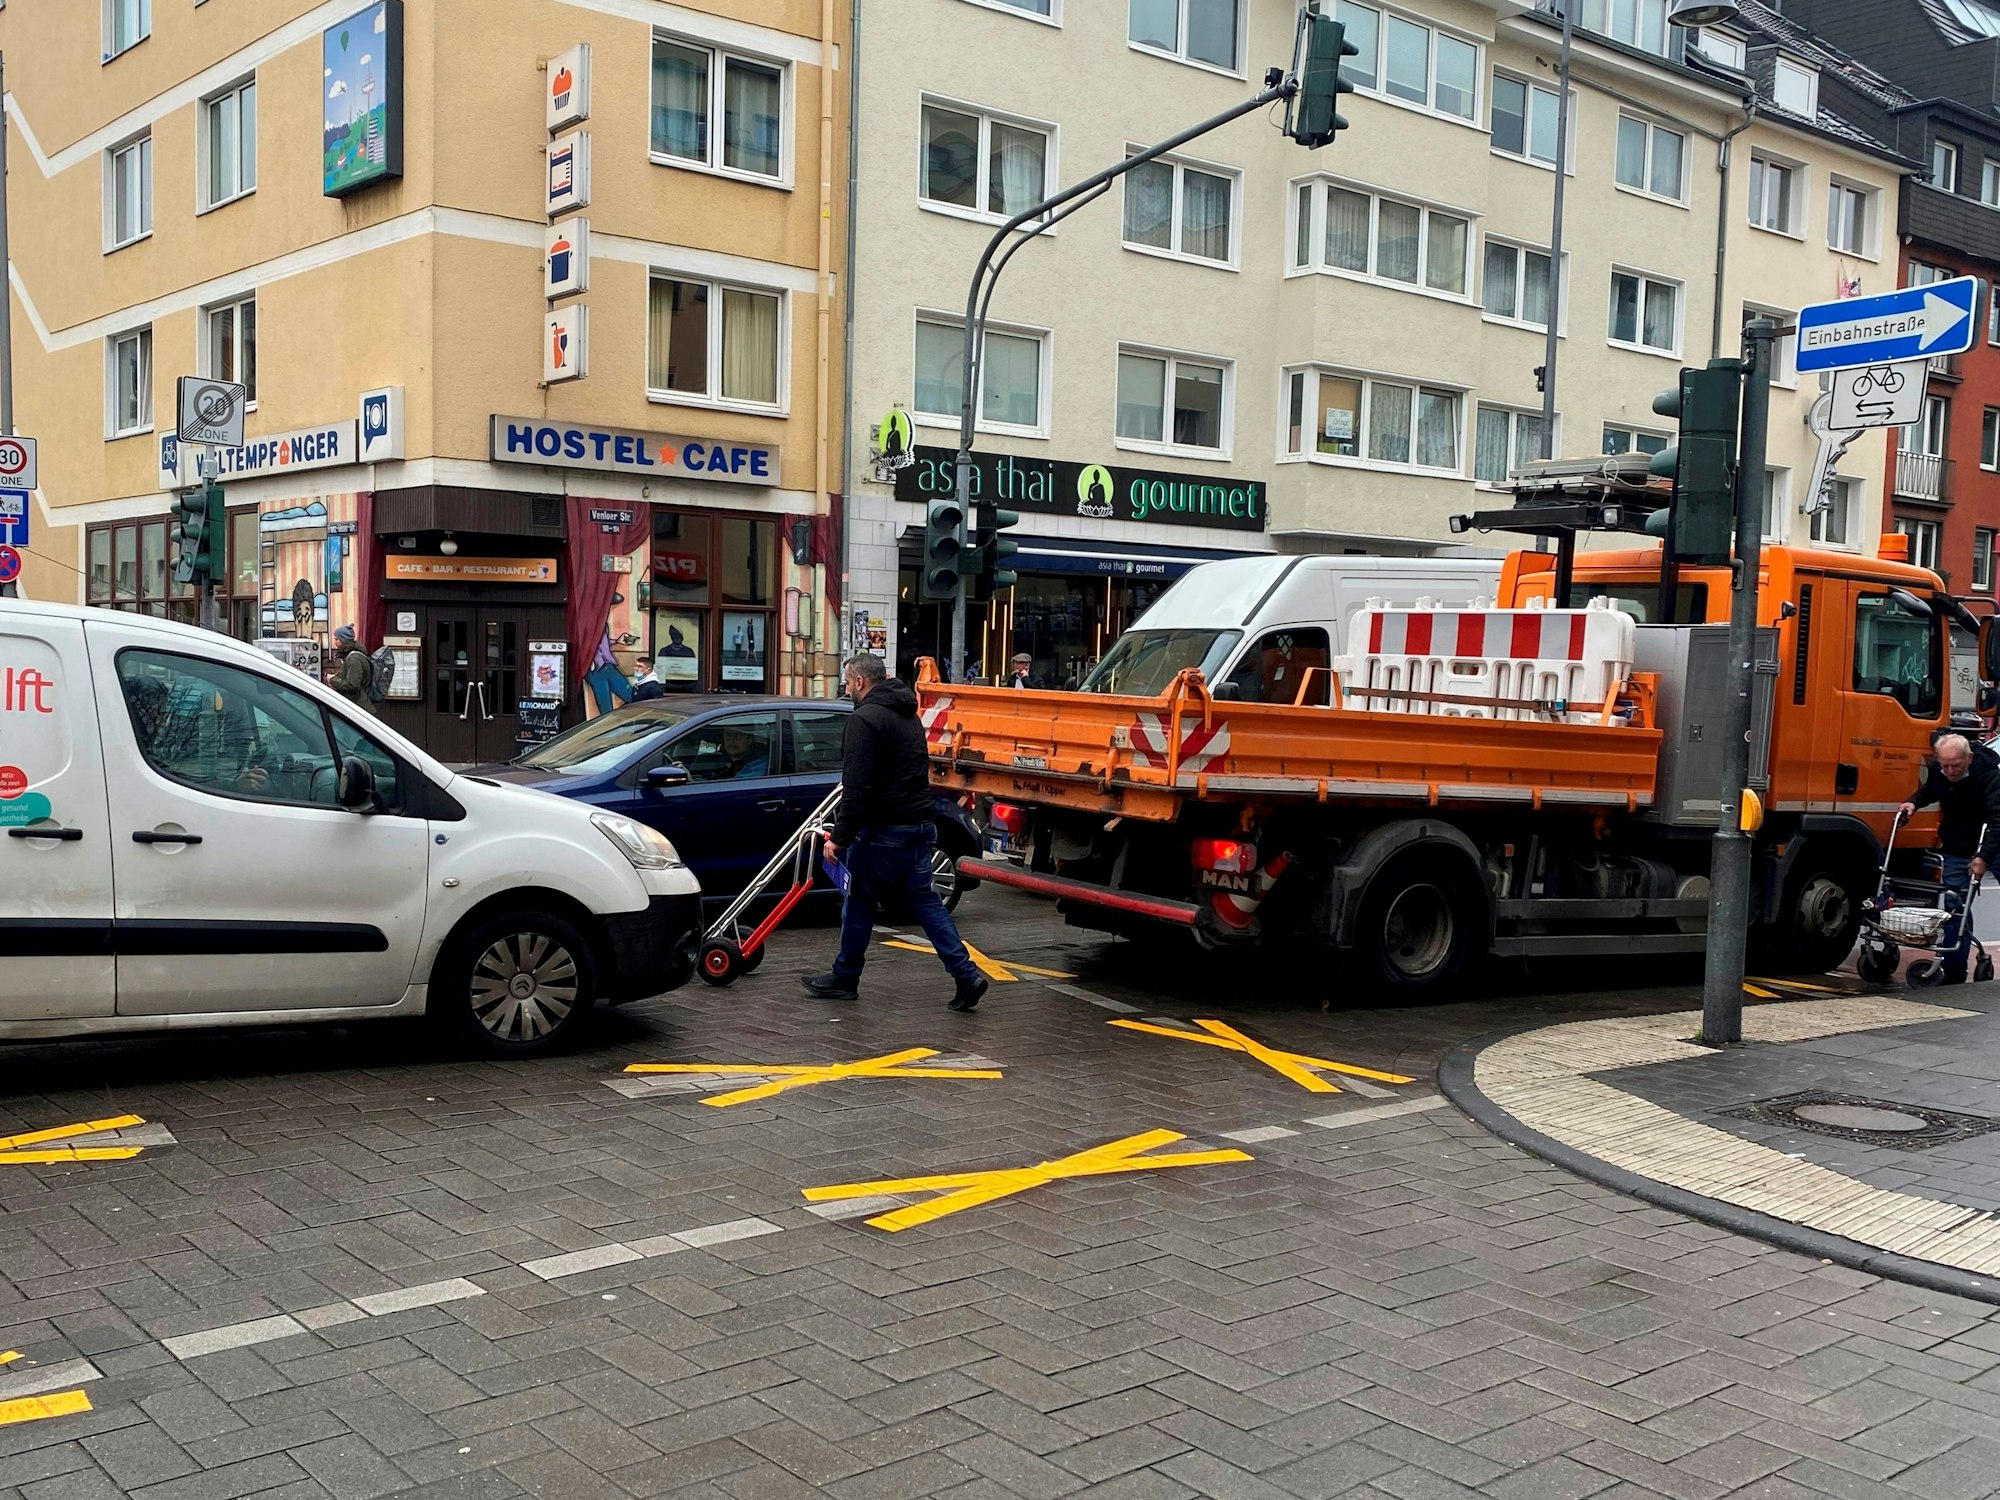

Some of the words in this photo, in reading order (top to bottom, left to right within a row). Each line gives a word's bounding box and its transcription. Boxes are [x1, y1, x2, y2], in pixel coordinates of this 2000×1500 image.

[1807, 316, 1926, 346] Einbahnstraße
[203, 395, 226, 416] 20
[197, 429, 229, 442] ZONE
[0, 449, 20, 465] 30
[507, 424, 655, 466] HOSTEL
[682, 443, 769, 477] CAFE
[0, 476, 23, 486] ONE
[918, 458, 983, 496] asa
[996, 456, 1055, 503] thai
[1130, 478, 1258, 520] gourmet
[397, 564, 423, 573] CAFE
[432, 565, 453, 574] BAR
[463, 566, 528, 576] RESTAURANT
[1098, 561, 1112, 571] asia
[1113, 562, 1126, 573] thai
[1135, 564, 1165, 574] gourmet
[0, 667, 53, 713] lft
[2, 803, 28, 813] gesund
[1202, 870, 1249, 892] MAN
